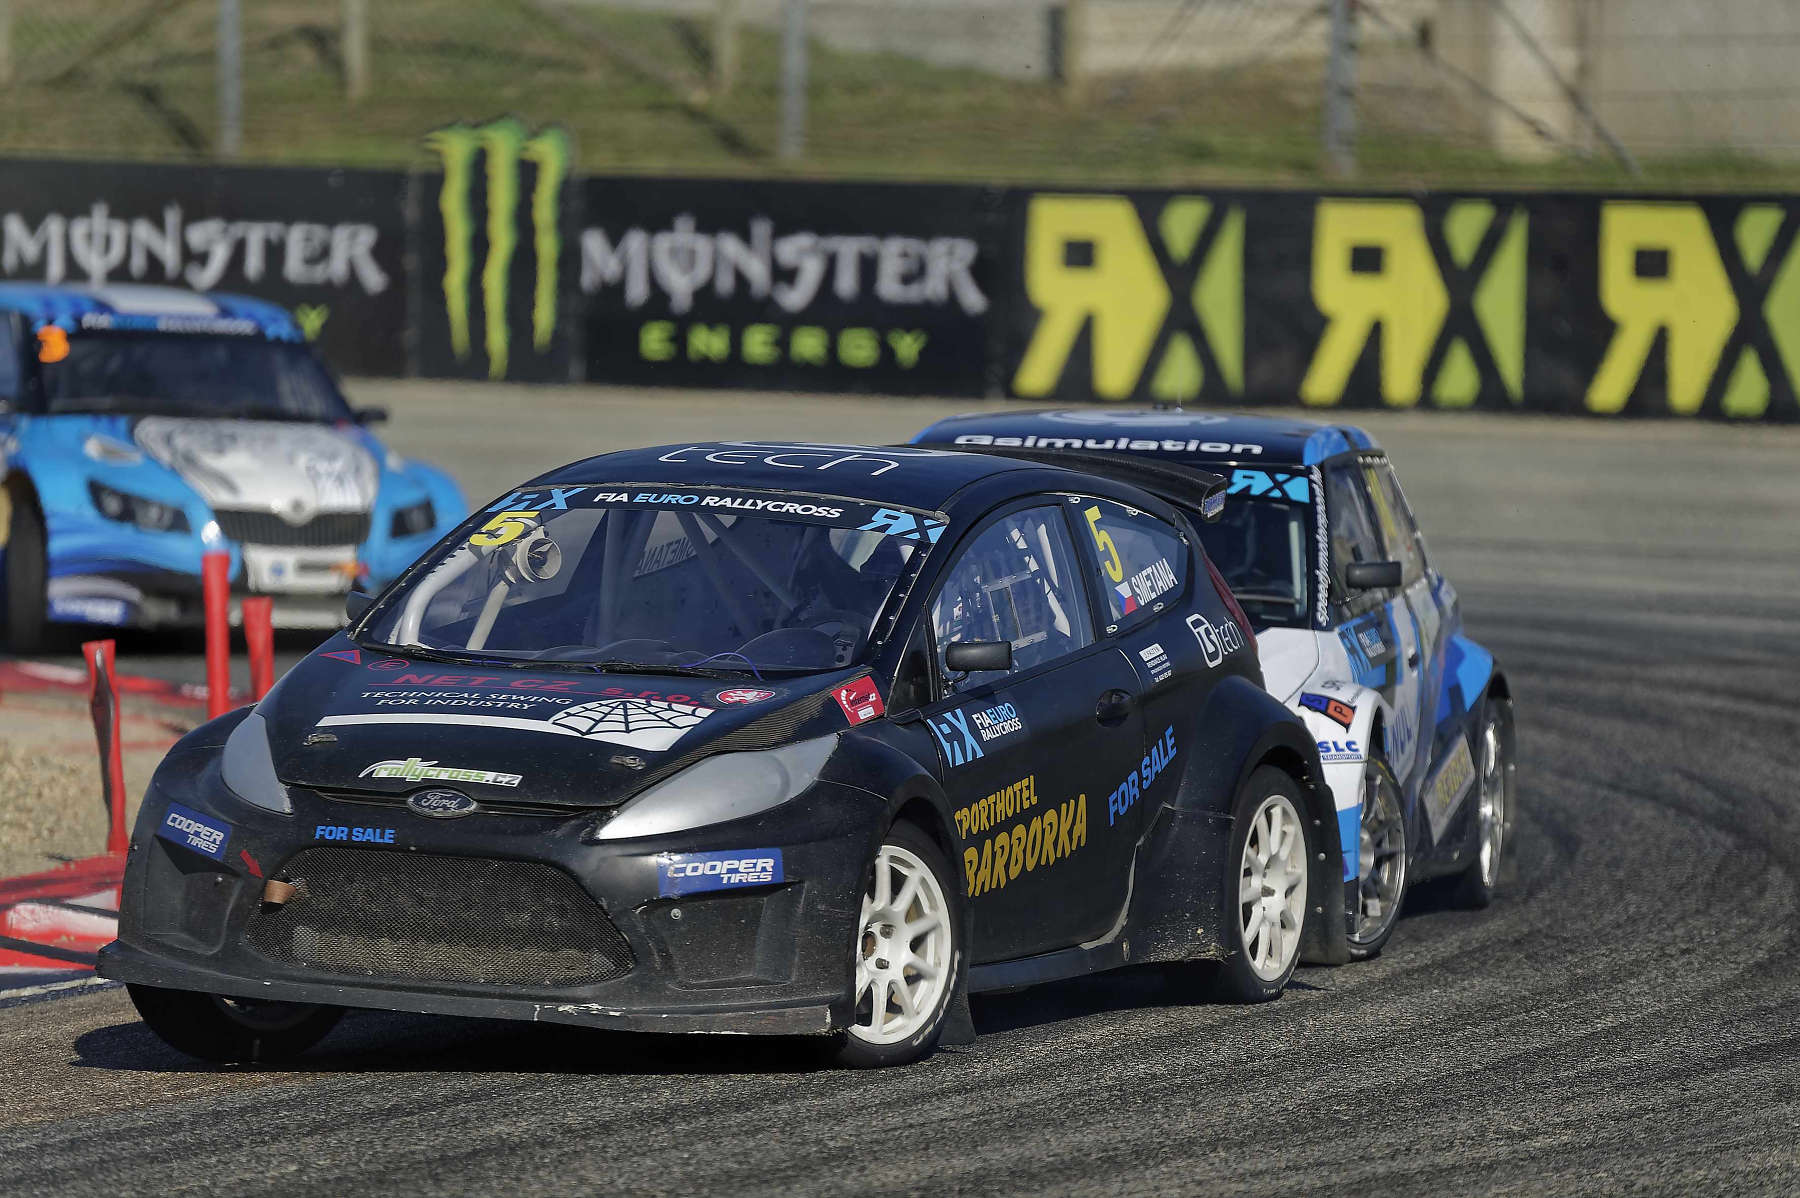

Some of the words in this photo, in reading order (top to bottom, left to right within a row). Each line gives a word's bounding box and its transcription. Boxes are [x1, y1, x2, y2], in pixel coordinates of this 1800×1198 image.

[2, 202, 390, 295] MONSTER
[580, 212, 988, 316] MONSTER
[37, 325, 70, 363] 3
[638, 319, 929, 368] ENERGY
[593, 492, 629, 503] FIA
[633, 493, 700, 505] EURO
[700, 496, 845, 519] RALLYCROSS
[469, 511, 540, 546] 5
[1084, 505, 1123, 583] 5
[1131, 557, 1179, 606] SMETANA
[392, 673, 502, 687] NET
[510, 679, 582, 691] CZ
[361, 691, 481, 700] TECHNICAL
[486, 693, 574, 705] SEWING
[424, 699, 537, 710] INDUSTRY
[980, 717, 1022, 742] RALLYCROSS
[374, 758, 518, 786] rallycross.cz
[1108, 770, 1140, 827] FOR
[1141, 723, 1177, 790] SALE
[421, 792, 459, 809] Ford
[167, 813, 225, 845] COOPER
[315, 825, 348, 841] FOR
[352, 827, 396, 843] SALE
[186, 834, 219, 854] TIRES
[963, 793, 1087, 898] BARBORKA
[667, 858, 775, 878] COOPER
[720, 872, 773, 884] TIRES
